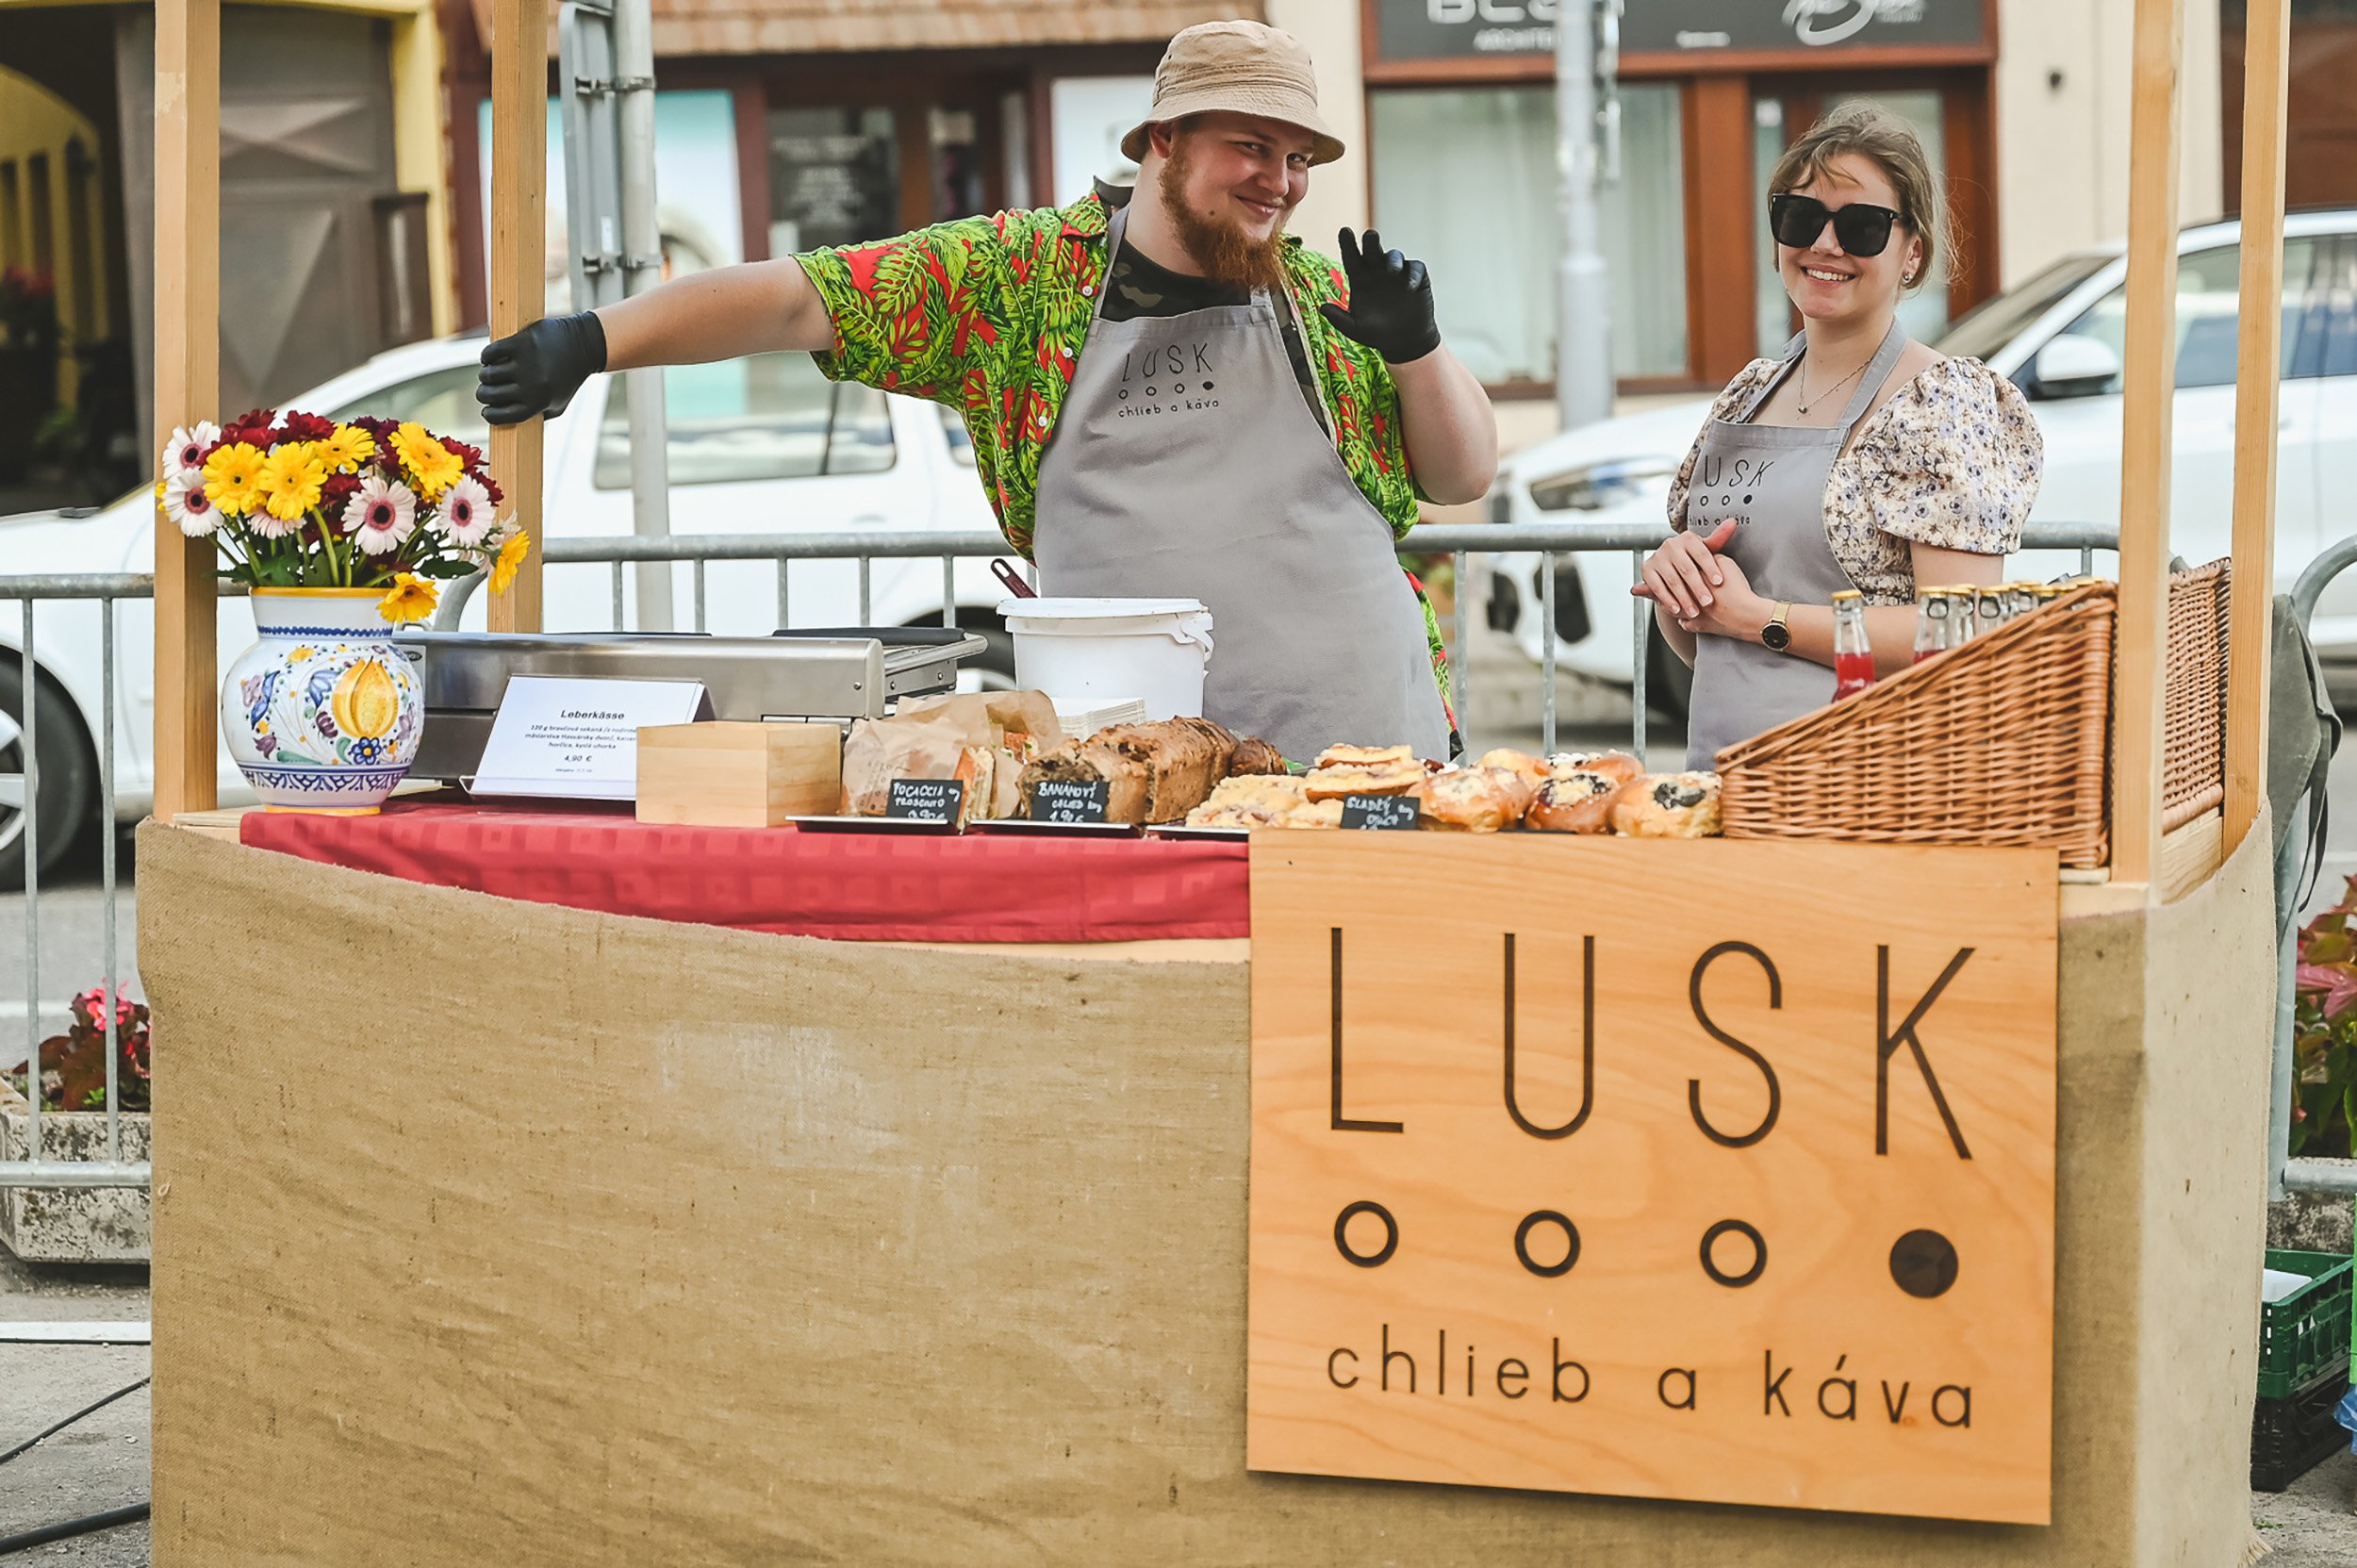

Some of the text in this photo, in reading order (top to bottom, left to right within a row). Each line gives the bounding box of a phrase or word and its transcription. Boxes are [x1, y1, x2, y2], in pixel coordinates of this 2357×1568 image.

[1122, 342, 1212, 383] LUSK
[1118, 398, 1220, 419] chlieb a káva
[1704, 454, 1775, 487] USK
[560, 709, 625, 721] Leberkässe
[1330, 926, 1977, 1161] LUSK
[1327, 1322, 1972, 1429] chlieb a káva
